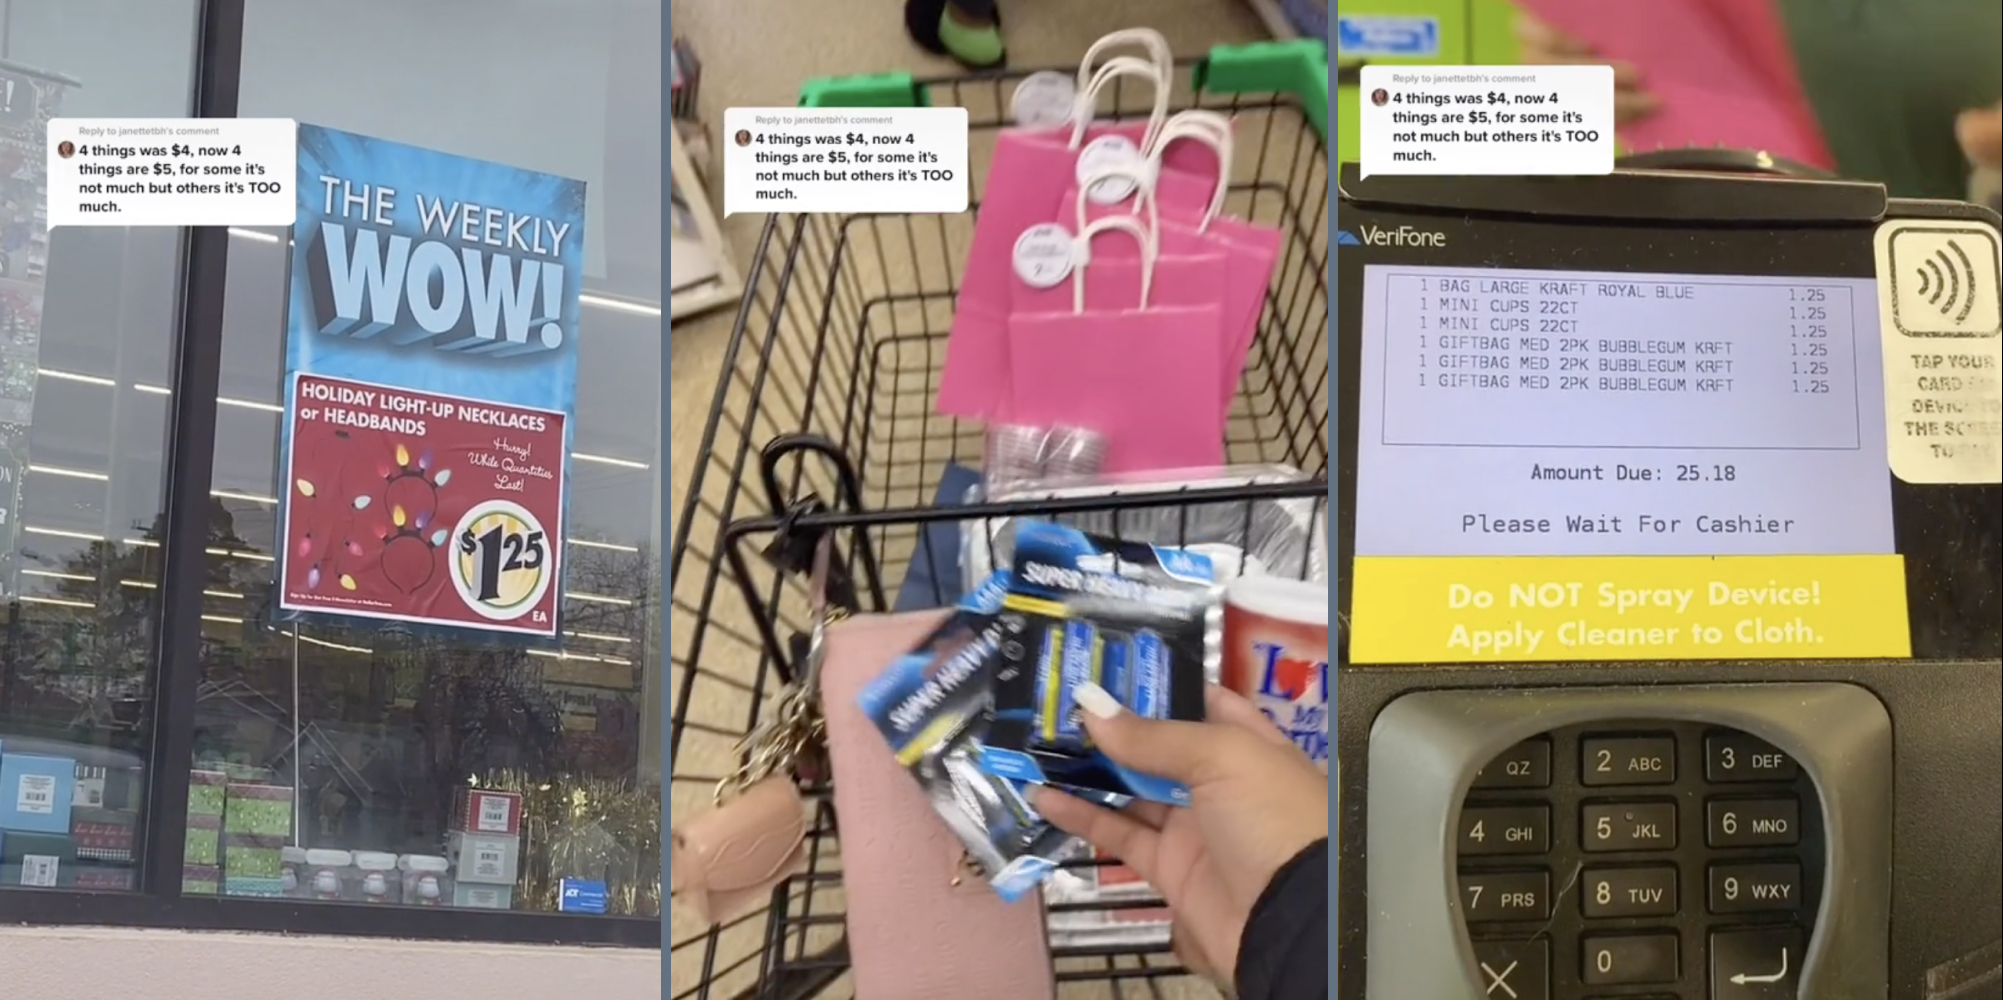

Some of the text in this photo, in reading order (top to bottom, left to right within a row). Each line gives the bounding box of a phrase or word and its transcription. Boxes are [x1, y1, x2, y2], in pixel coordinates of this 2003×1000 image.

[320, 175, 569, 256] THE WEEKLY
[1360, 225, 1446, 247] VeriFone
[315, 221, 564, 350] WOW!
[1440, 279, 1826, 302] BAG LARGE KRAFT ROYAL BLUE 1.25
[1439, 298, 1827, 320] MINI CUPS 22CT 1.25
[1439, 317, 1827, 338] MINI CUPS 22CT 1.25
[1439, 336, 1827, 356] GIFTBAG MED 2PK BUBBLEGUM KRFT 1.25
[1439, 354, 1828, 375] GIFTBAG MED 2PK BUBBLEGUM KRFT 1.25
[1910, 354, 1944, 369] TAP
[1439, 374, 1829, 393] GIFTBAG MED 2PK BUBBLEGUM KRFT 1.25
[301, 382, 546, 432] HOLIDAY LIGHT-UP NECKLACES
[300, 408, 426, 436] or HEADBANDS
[493, 437, 532, 461] Hurry!
[467, 451, 553, 480] While Quantities
[1530, 463, 1736, 481] Amount Due: 25.18
[494, 474, 525, 492] Last!
[1462, 514, 1794, 533] Please Wait For Cashier
[1448, 579, 1821, 614] Do NOT Spray Device!
[532, 611, 547, 622] EA
[1447, 618, 1824, 655] Apply Cleaner to Cloth.
[1506, 761, 1531, 775] QZ
[1597, 750, 1662, 771] 2 ABC
[1721, 747, 1783, 769] 3 DEF
[1469, 820, 1533, 842] 4 GHI
[1597, 817, 1661, 839] 5 JKL
[1722, 812, 1787, 834] 6 MNO
[1468, 886, 1535, 909] 7 PRS
[1596, 881, 1663, 904] 8 TUV
[1724, 877, 1791, 899] 9 WXY
[1597, 950, 1612, 972] 0
